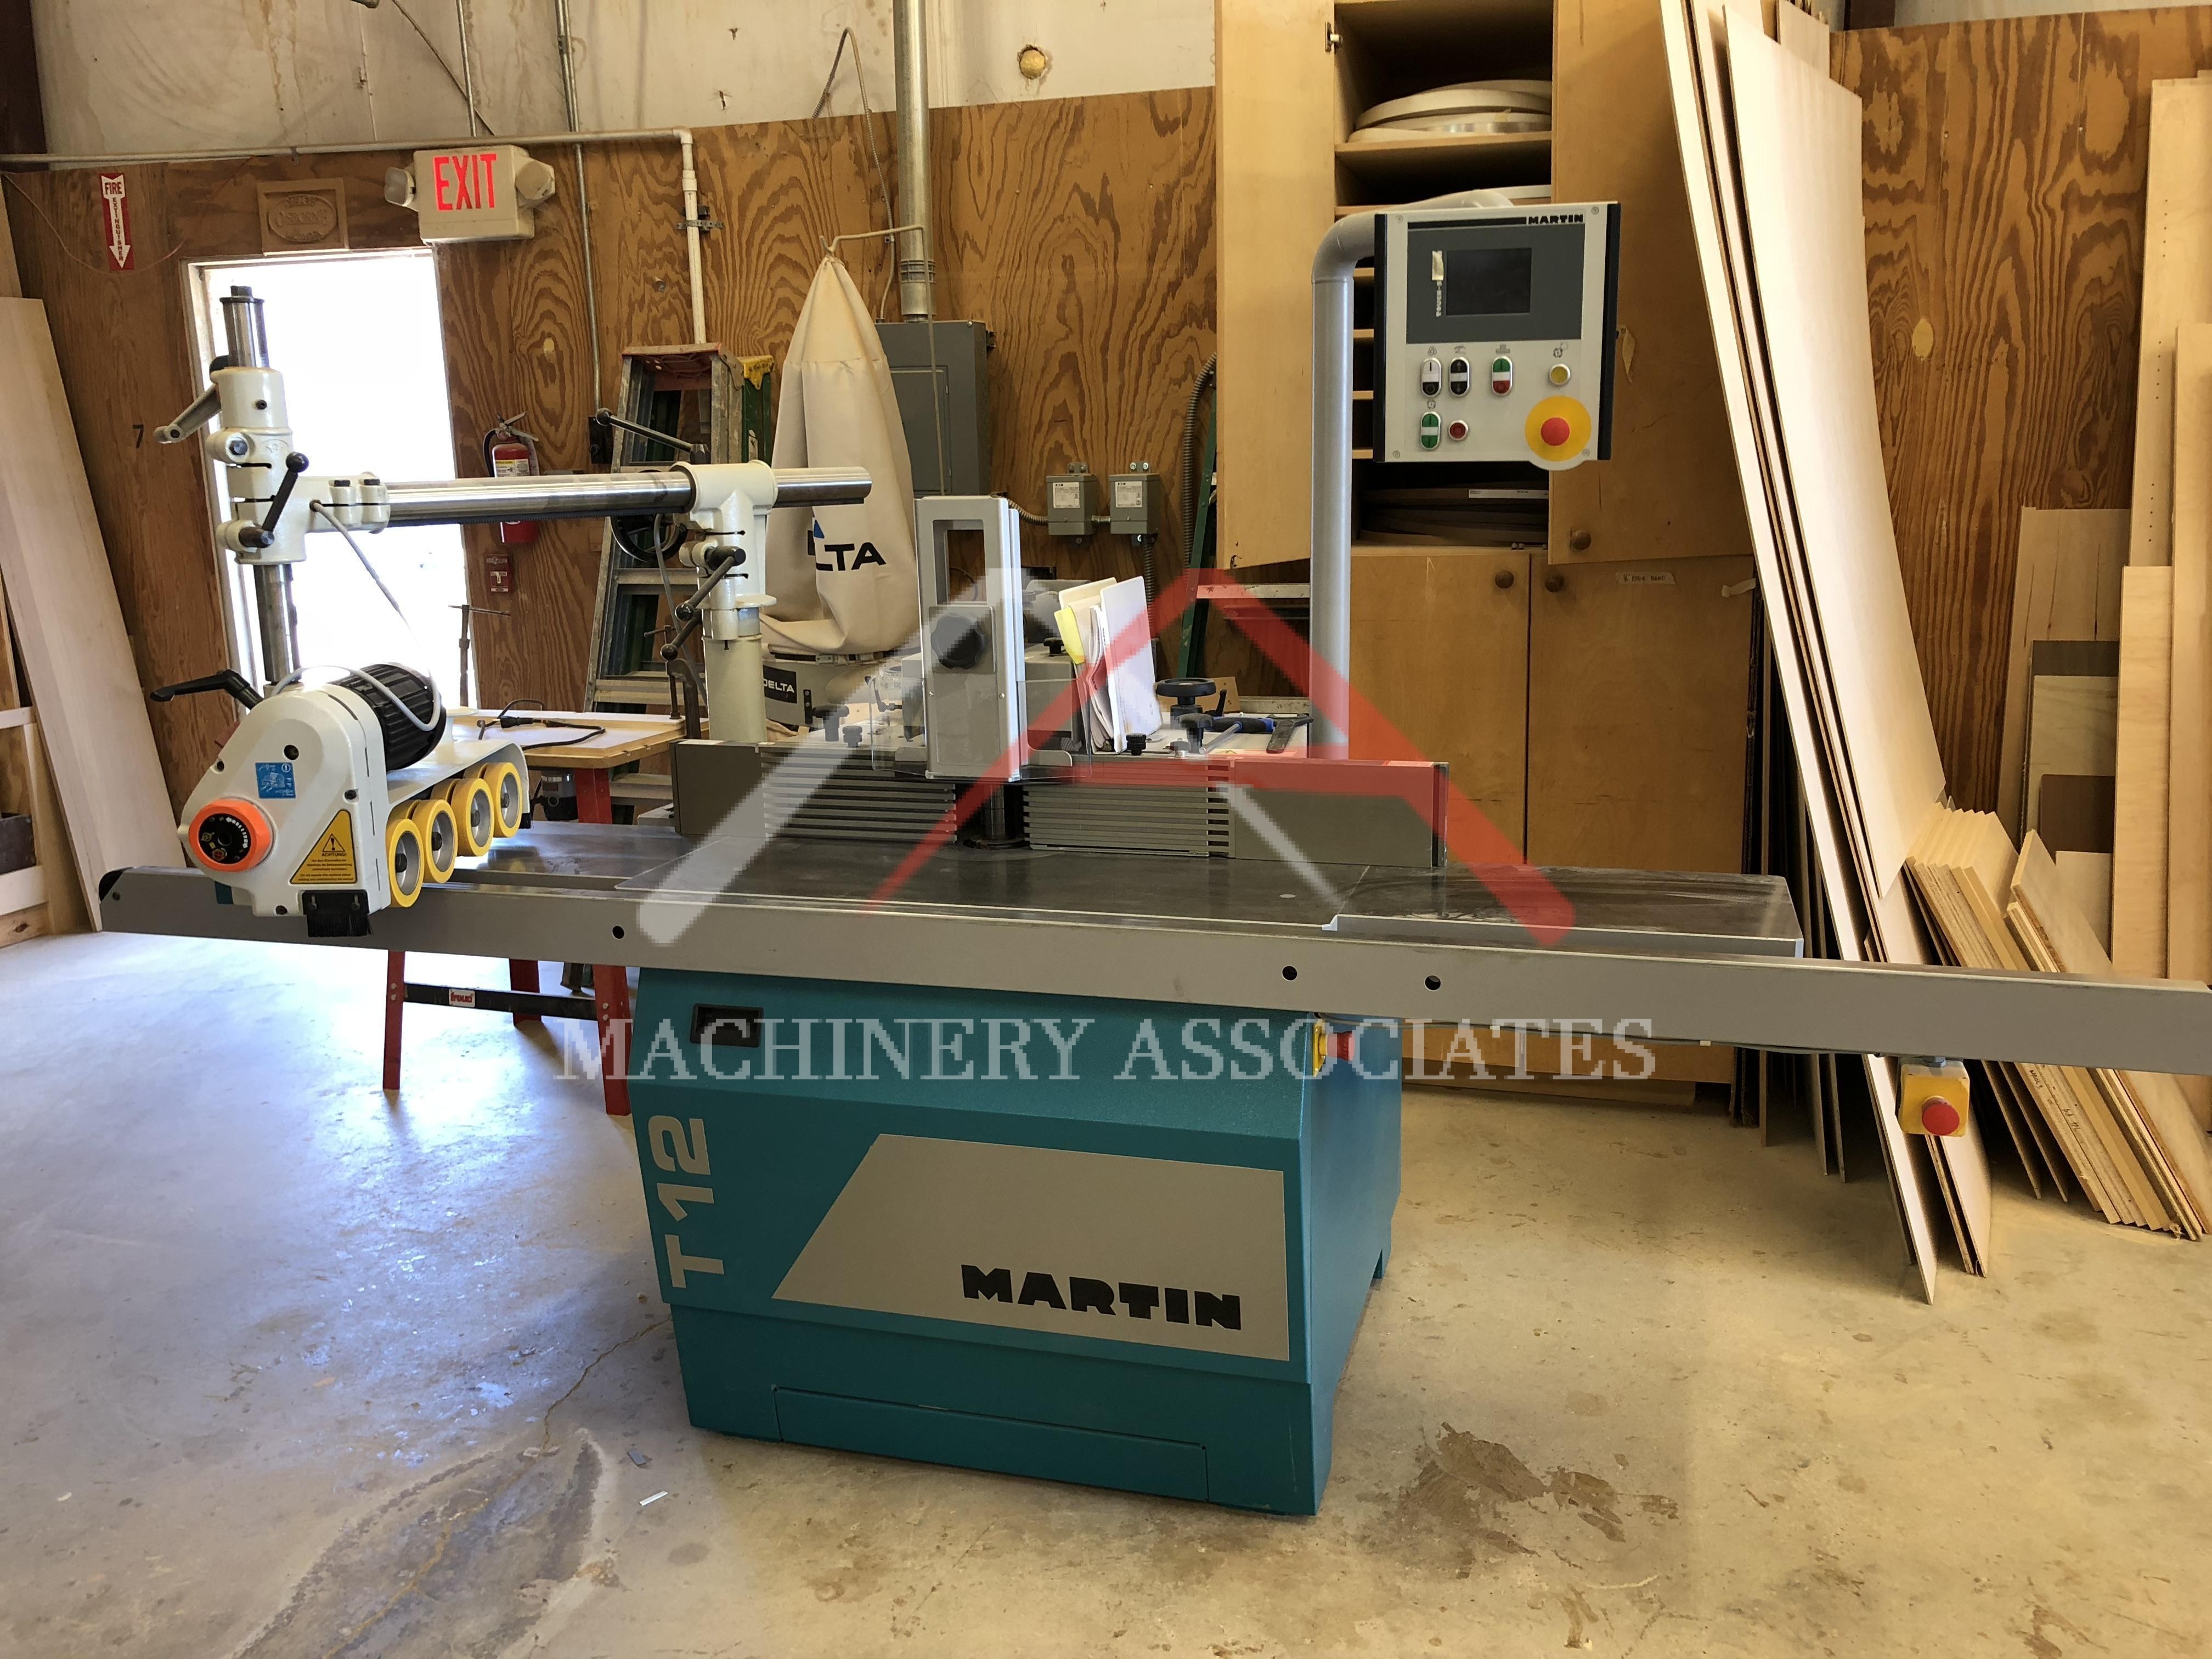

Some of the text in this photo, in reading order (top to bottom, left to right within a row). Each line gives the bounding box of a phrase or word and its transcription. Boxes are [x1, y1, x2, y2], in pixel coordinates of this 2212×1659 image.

[104, 182, 122, 194] FIRE
[433, 153, 496, 211] EXIT
[112, 197, 124, 261] EXTINGUISHER
[1528, 214, 1583, 224] MARTIN
[132, 424, 144, 449] 7
[764, 678, 794, 693] DELTA
[648, 1115, 725, 1289] T12
[961, 1264, 1242, 1330] MARTIN
